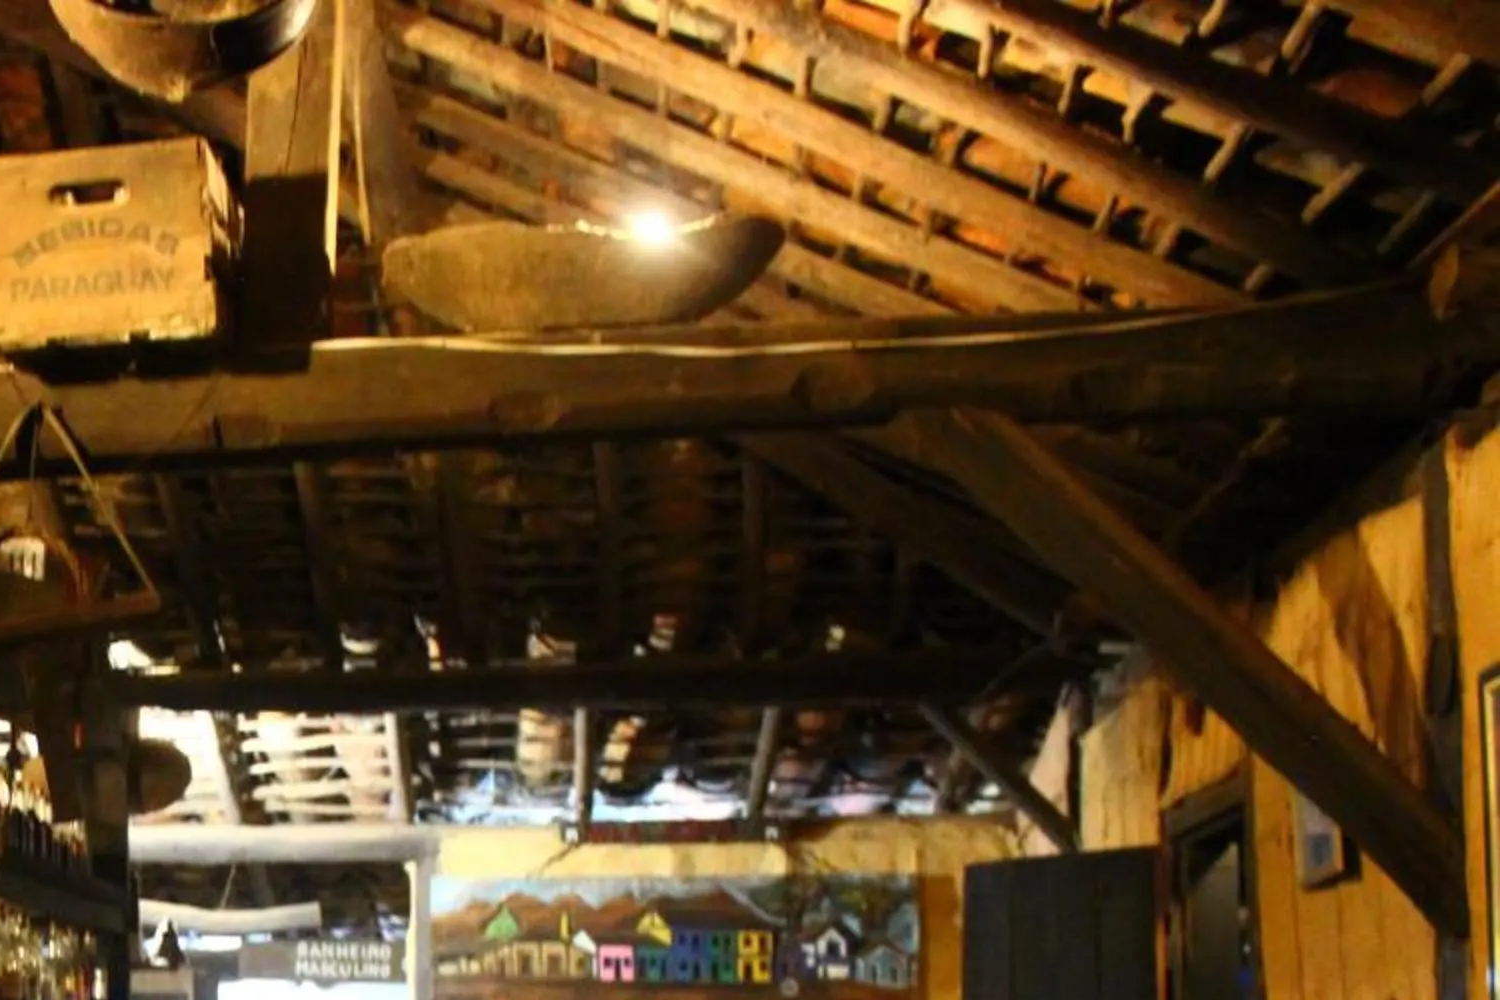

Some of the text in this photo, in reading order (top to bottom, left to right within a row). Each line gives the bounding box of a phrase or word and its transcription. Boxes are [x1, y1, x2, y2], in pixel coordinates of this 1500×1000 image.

[10, 267, 175, 303] PARAGUAY
[297, 941, 392, 960] BANHEIRO
[295, 960, 390, 978] MASCULINO
